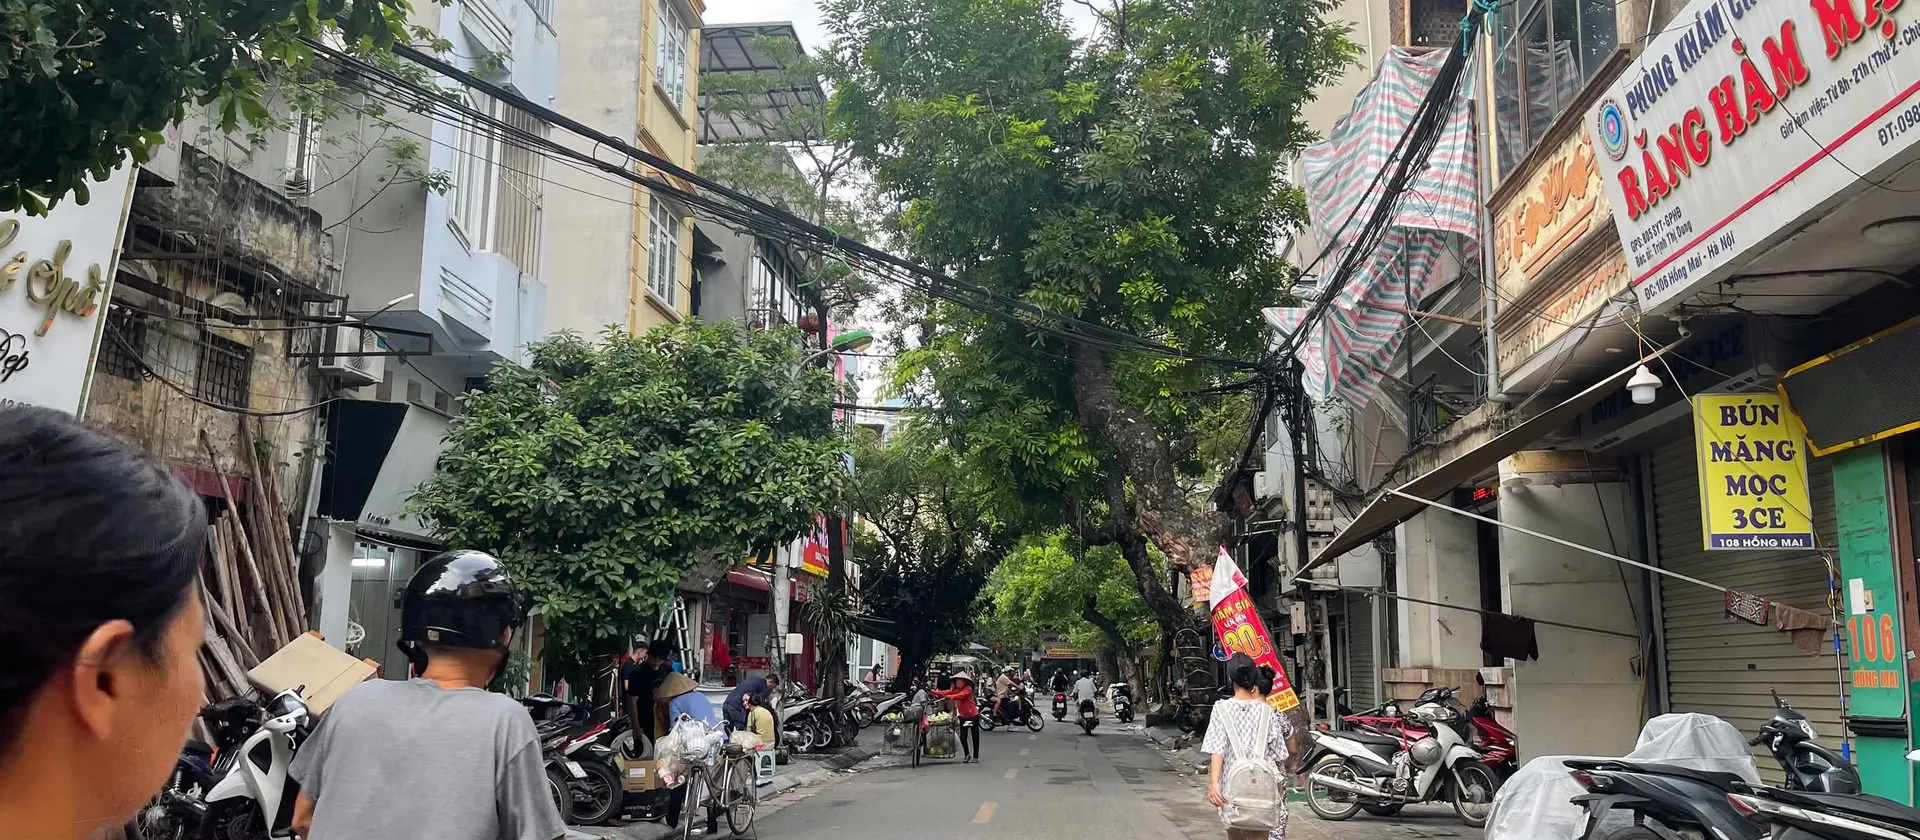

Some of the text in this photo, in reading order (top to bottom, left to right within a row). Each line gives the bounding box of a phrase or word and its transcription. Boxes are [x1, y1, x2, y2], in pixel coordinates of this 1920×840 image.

[1626, 53, 1678, 121] PHÒNG
[1674, 1, 1727, 73] KHÁM
[1618, 105, 1711, 221] RĂNG
[1708, 18, 1811, 147] HÀM
[1780, 116, 1795, 139] Giờ
[1686, 252, 1703, 273] Mai
[1707, 240, 1719, 260] Hà
[1720, 230, 1736, 252] Nội
[1719, 399, 1780, 427] BÚN
[1710, 433, 1797, 462] MĂNG
[1724, 474, 1787, 502] MỌC
[1732, 506, 1787, 529] 3CE
[1719, 538, 1740, 547] 108
[1781, 538, 1804, 547] MAI
[1848, 614, 1896, 662] 106
[1880, 669, 1899, 688] MAI
